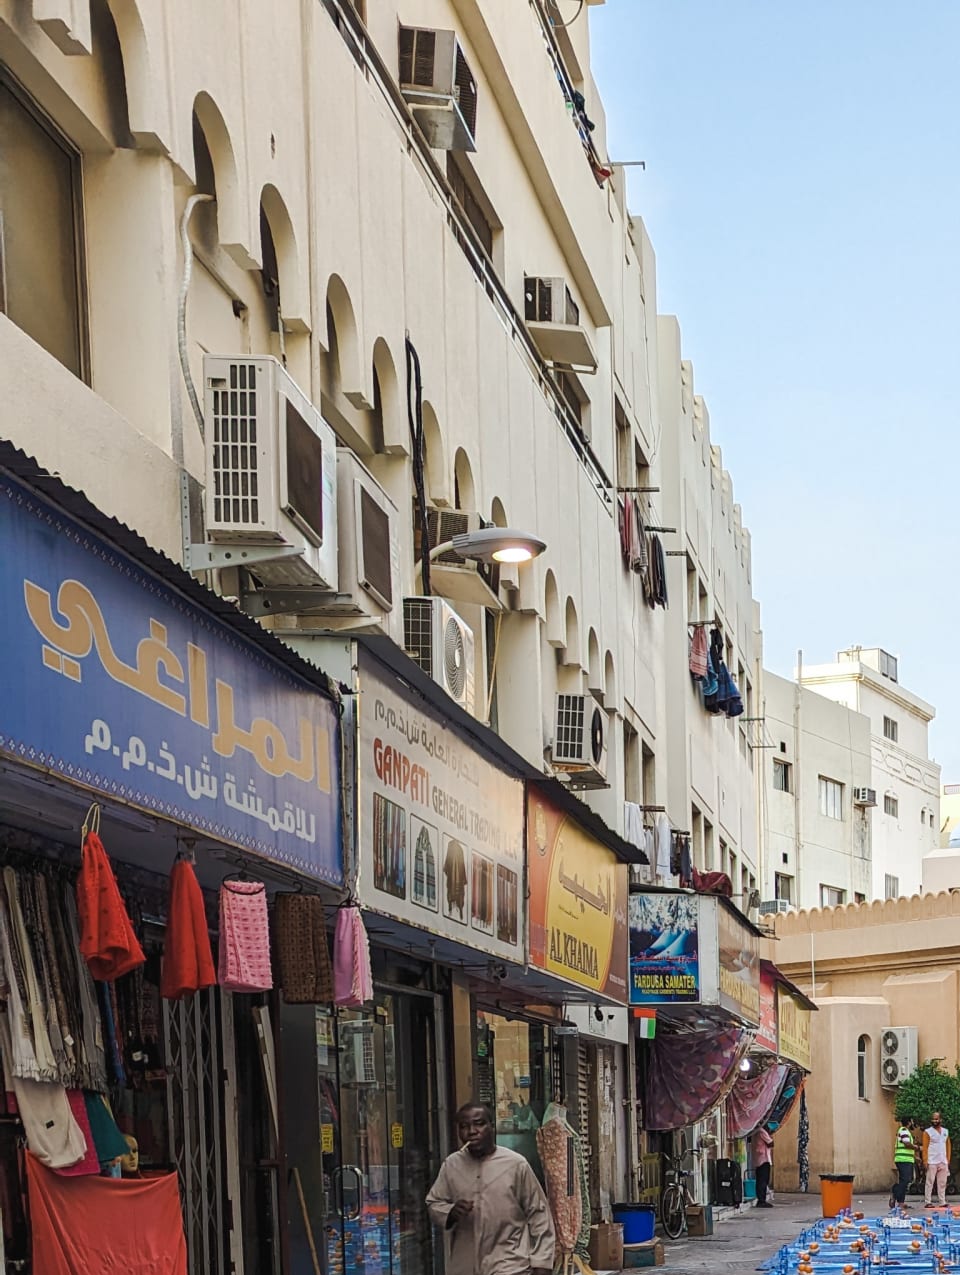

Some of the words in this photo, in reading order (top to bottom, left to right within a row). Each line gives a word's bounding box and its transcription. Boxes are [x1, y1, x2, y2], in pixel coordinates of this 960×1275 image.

[24, 578, 332, 794] المراغي
[373, 737, 431, 809] GANPATI
[431, 785, 469, 832] GENERAL
[550, 926, 563, 964] AL
[563, 934, 599, 980] KHAIMA
[634, 974, 664, 989] FARDUSA
[665, 975, 696, 989] SAMATER
